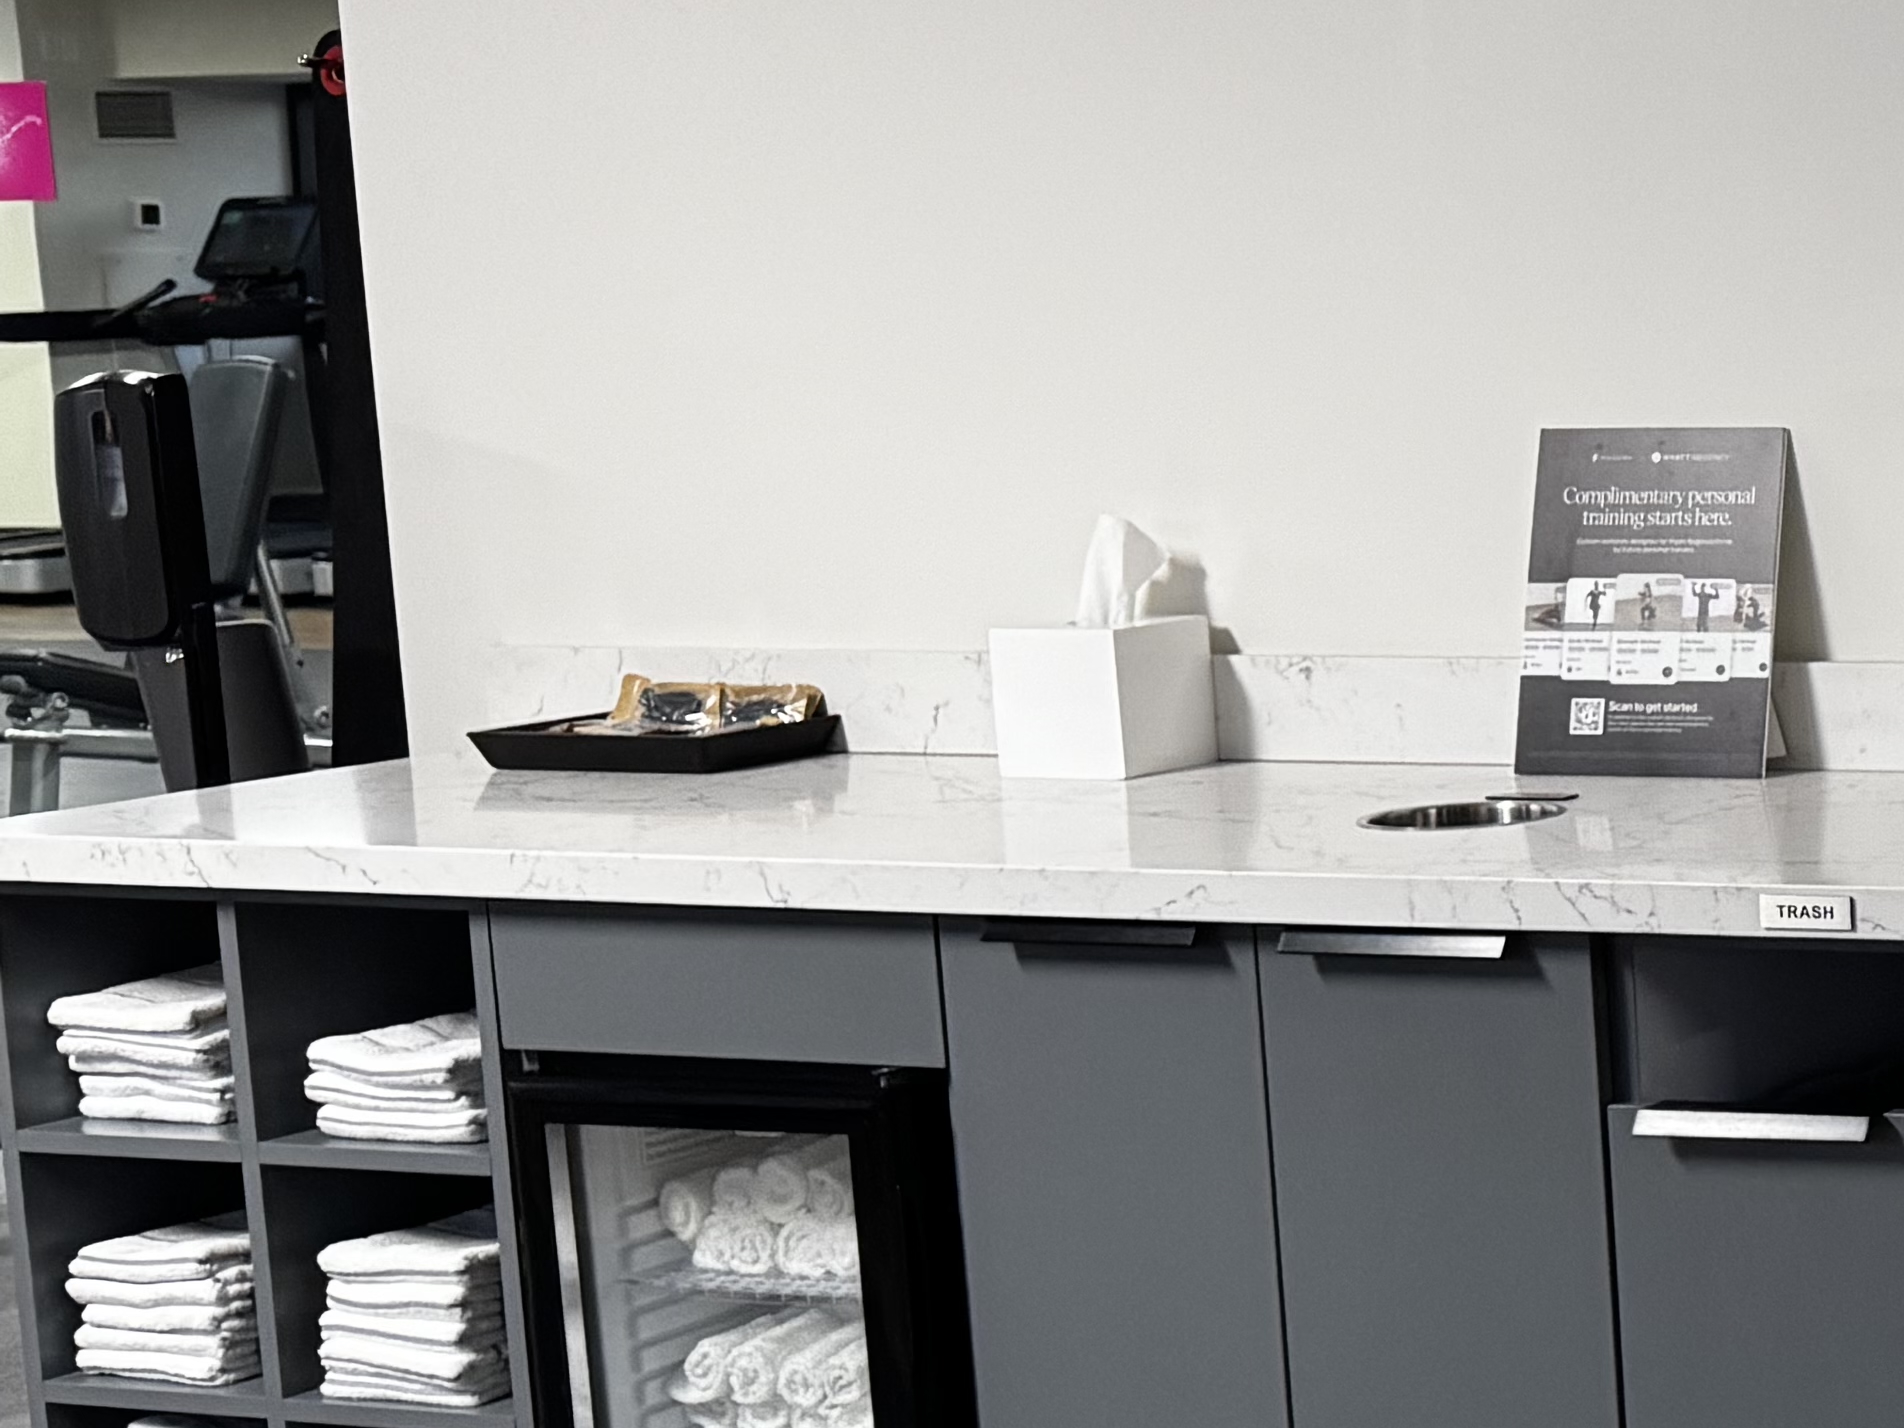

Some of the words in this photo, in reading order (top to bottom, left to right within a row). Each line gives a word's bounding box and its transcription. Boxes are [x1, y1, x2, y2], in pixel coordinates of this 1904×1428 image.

[1563, 485, 1685, 509] Complimentary
[1688, 485, 1756, 509] personal
[1582, 507, 1645, 530] training
[1647, 509, 1692, 526] starts
[1695, 507, 1733, 526] here.
[1608, 700, 1633, 712] Scan
[1634, 701, 1645, 712] to
[1646, 702, 1661, 714] get
[1663, 702, 1698, 713] started
[1776, 904, 1834, 920] TRASH
